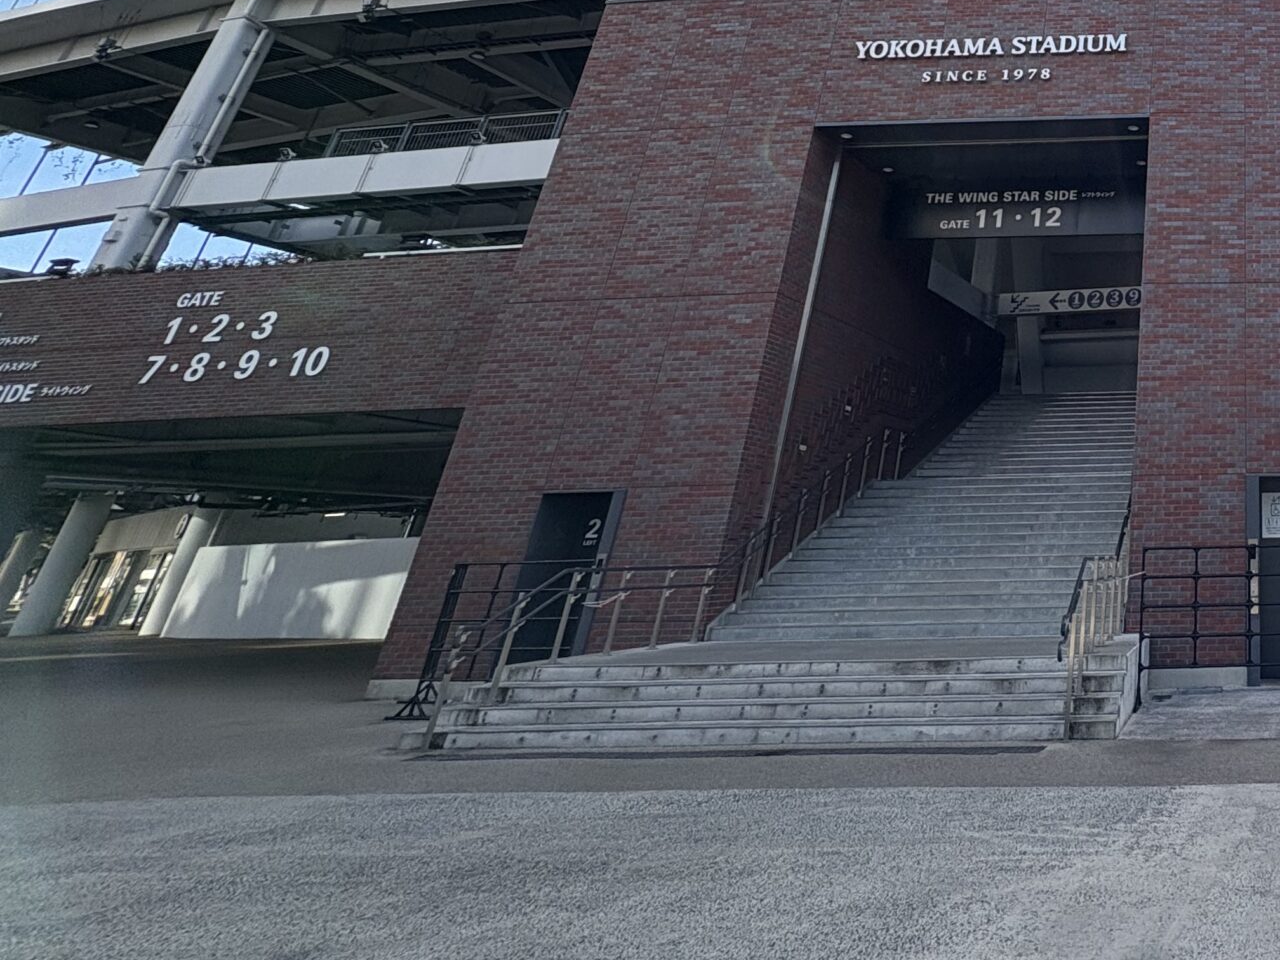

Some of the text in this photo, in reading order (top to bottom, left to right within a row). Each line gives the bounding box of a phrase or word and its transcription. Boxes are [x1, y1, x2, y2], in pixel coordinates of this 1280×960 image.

[855, 34, 1127, 59] YOKOHAMA STADIUM
[922, 68, 1051, 83] SINCE 1978
[926, 190, 1078, 204] THE WING STAR SIDE
[939, 220, 970, 230] GATE
[176, 290, 225, 309] GATE
[0, 383, 39, 403] IDE
[584, 518, 602, 538] 2
